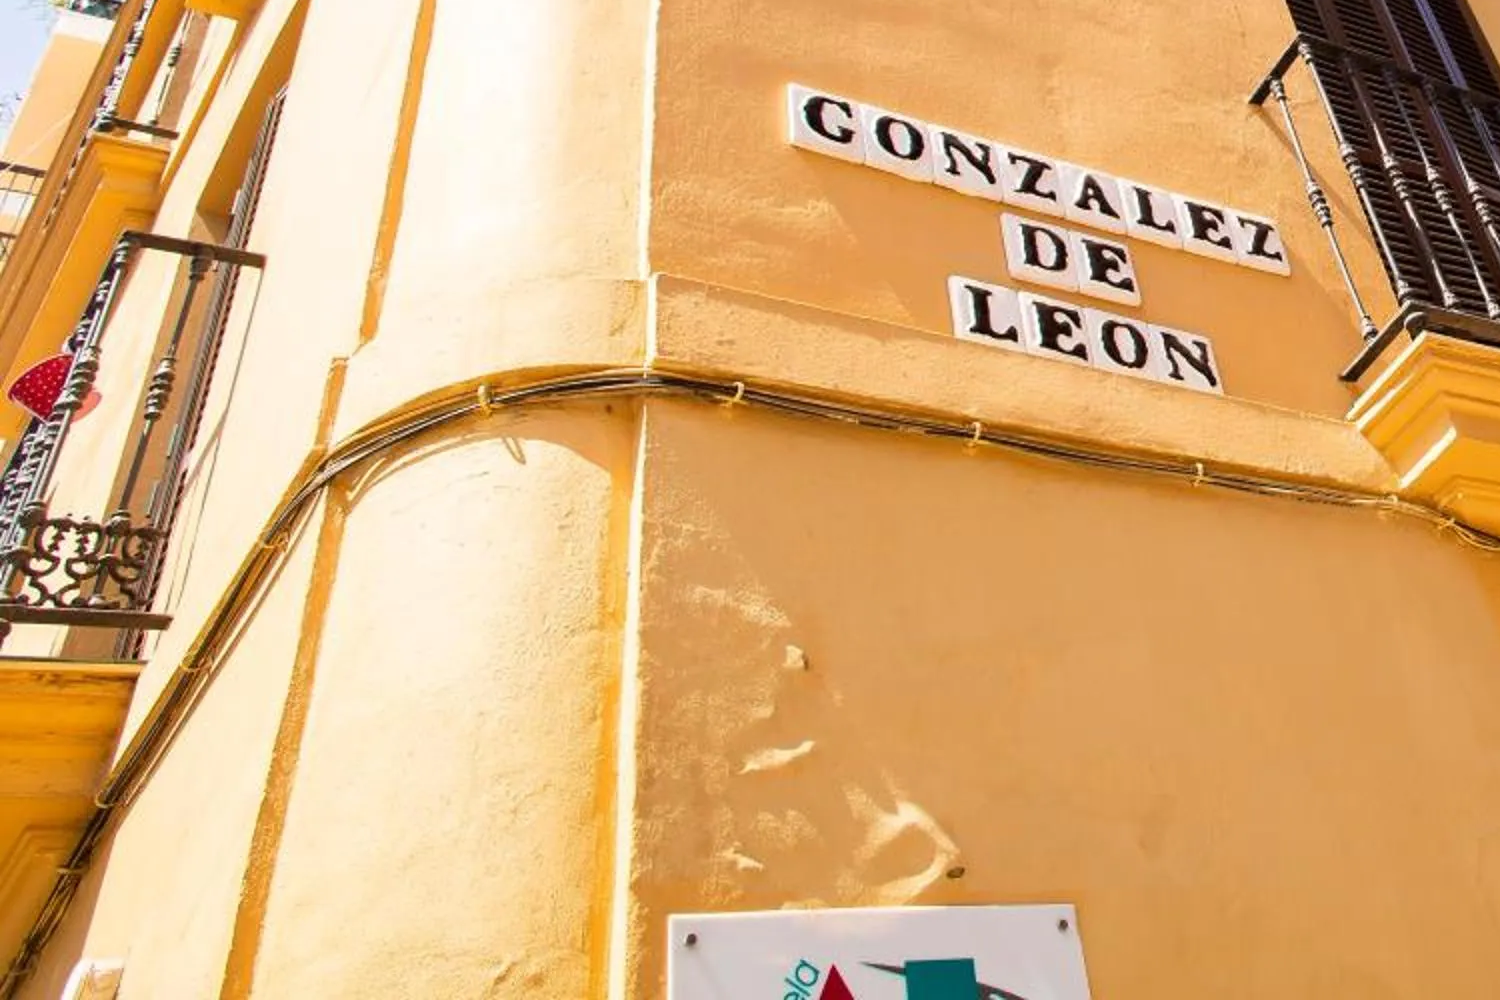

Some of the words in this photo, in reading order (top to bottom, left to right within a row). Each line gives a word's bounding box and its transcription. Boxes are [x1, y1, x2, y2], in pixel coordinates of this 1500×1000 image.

[802, 95, 1284, 262] GONZALEZ
[1020, 223, 1135, 293] DE
[963, 285, 1219, 388] LEON
